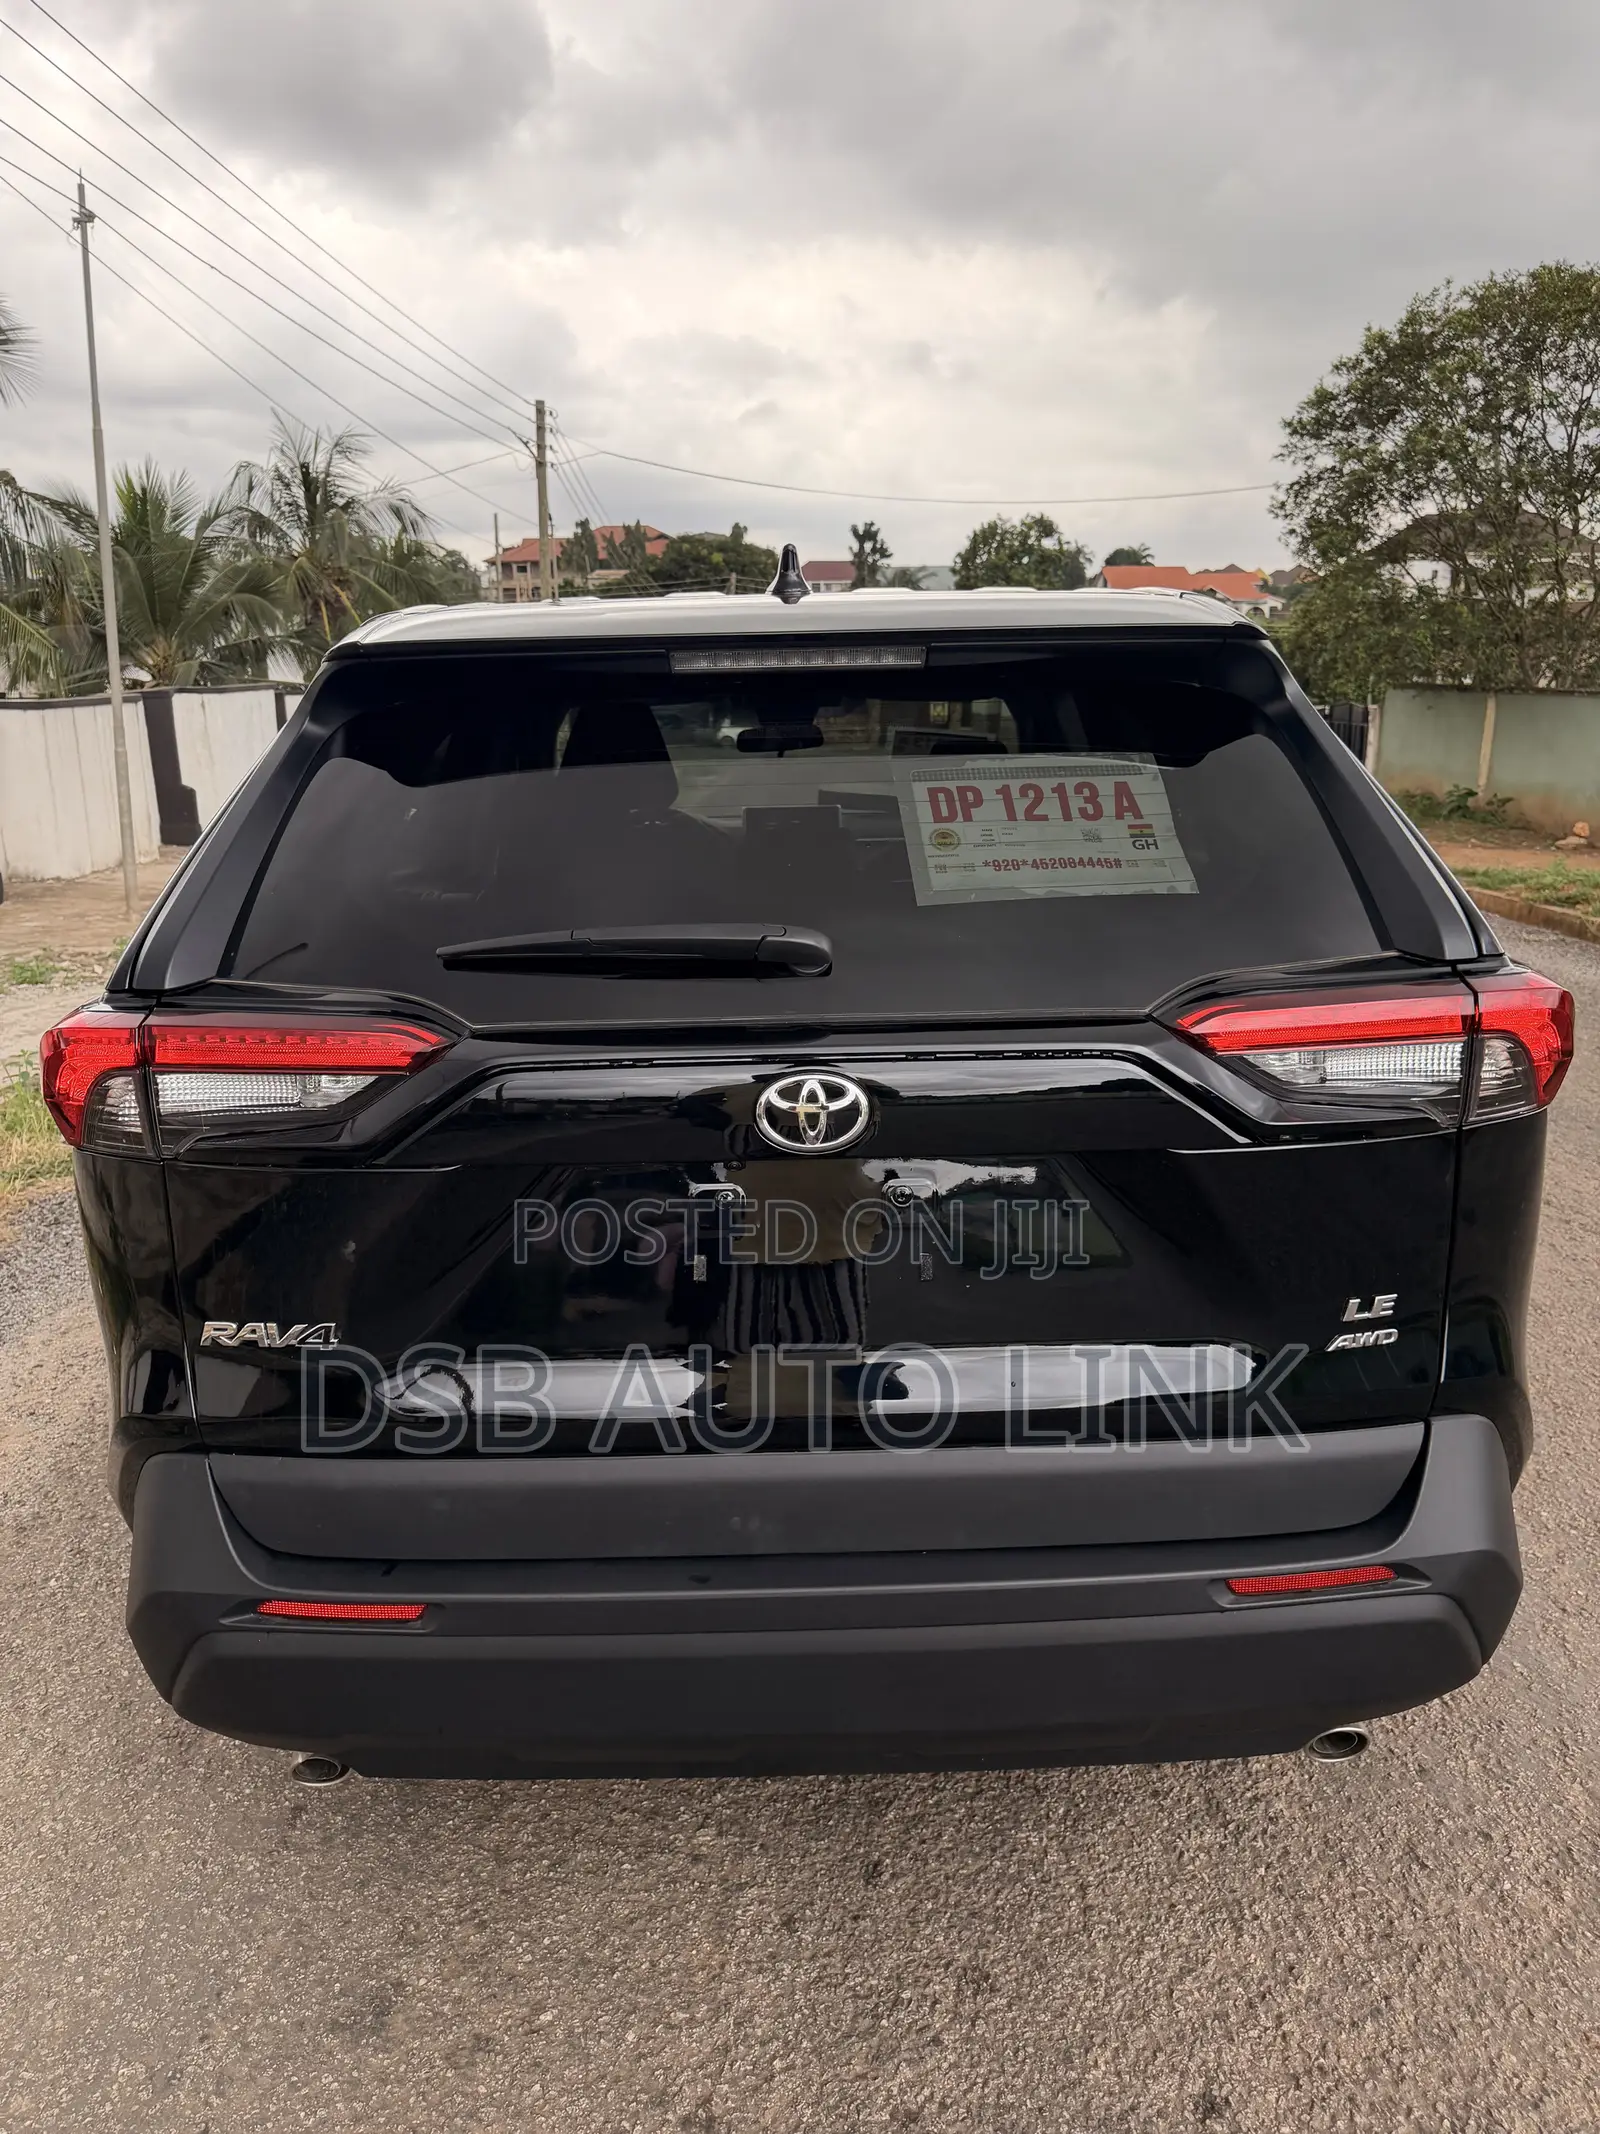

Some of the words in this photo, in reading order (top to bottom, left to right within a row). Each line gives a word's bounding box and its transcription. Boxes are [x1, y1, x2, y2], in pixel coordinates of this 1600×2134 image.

[926, 785, 984, 823] DP
[995, 781, 1104, 822] 1213
[1114, 781, 1144, 820] A
[1132, 839, 1159, 850] GH
[1342, 1293, 1398, 1322] LE
[200, 1321, 339, 1350] RAV4
[1324, 1328, 1399, 1352] AWD
